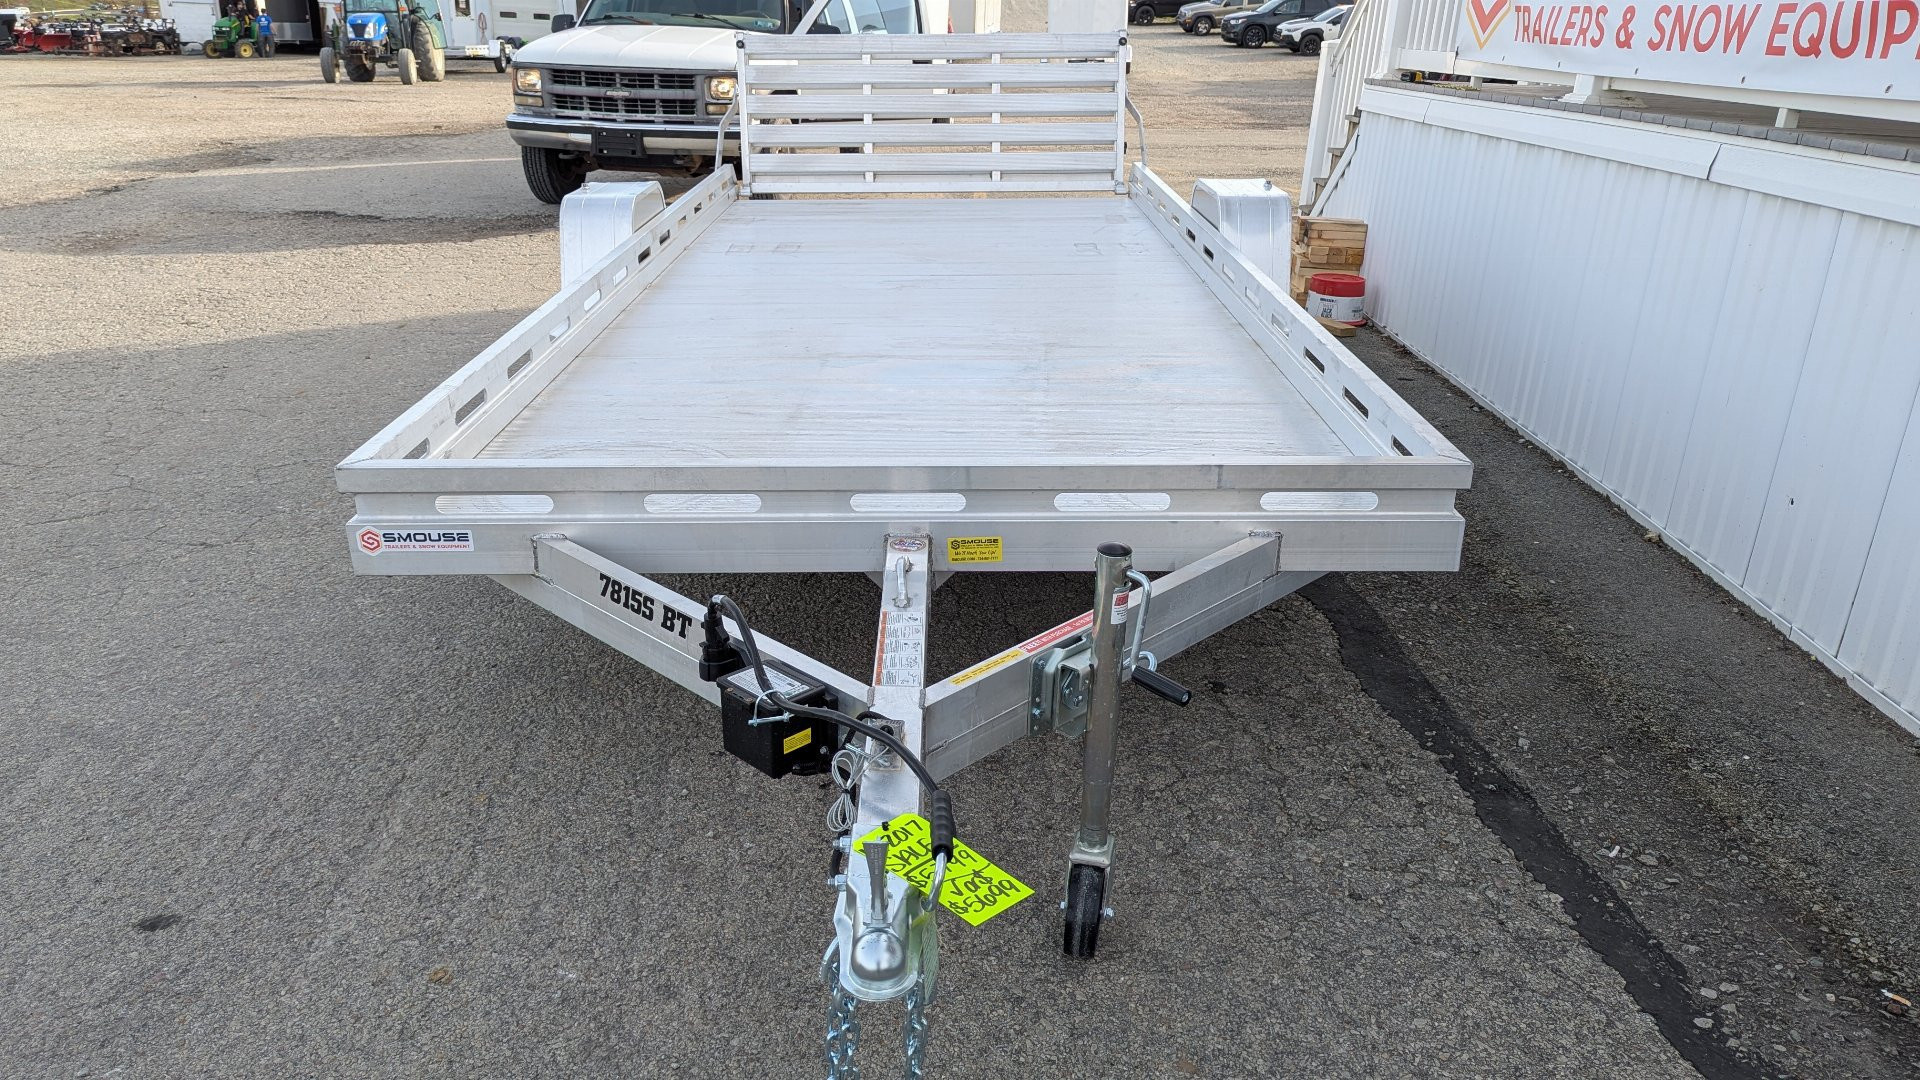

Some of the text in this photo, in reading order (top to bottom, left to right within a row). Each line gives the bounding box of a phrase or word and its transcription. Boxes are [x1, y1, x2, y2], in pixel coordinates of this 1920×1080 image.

[1513, 0, 1920, 60] TRAILERS & SNOW EQUIP
[382, 533, 470, 542] SMOUSE
[600, 572, 693, 639] 7815S BT
[947, 879, 1021, 914] $5699
